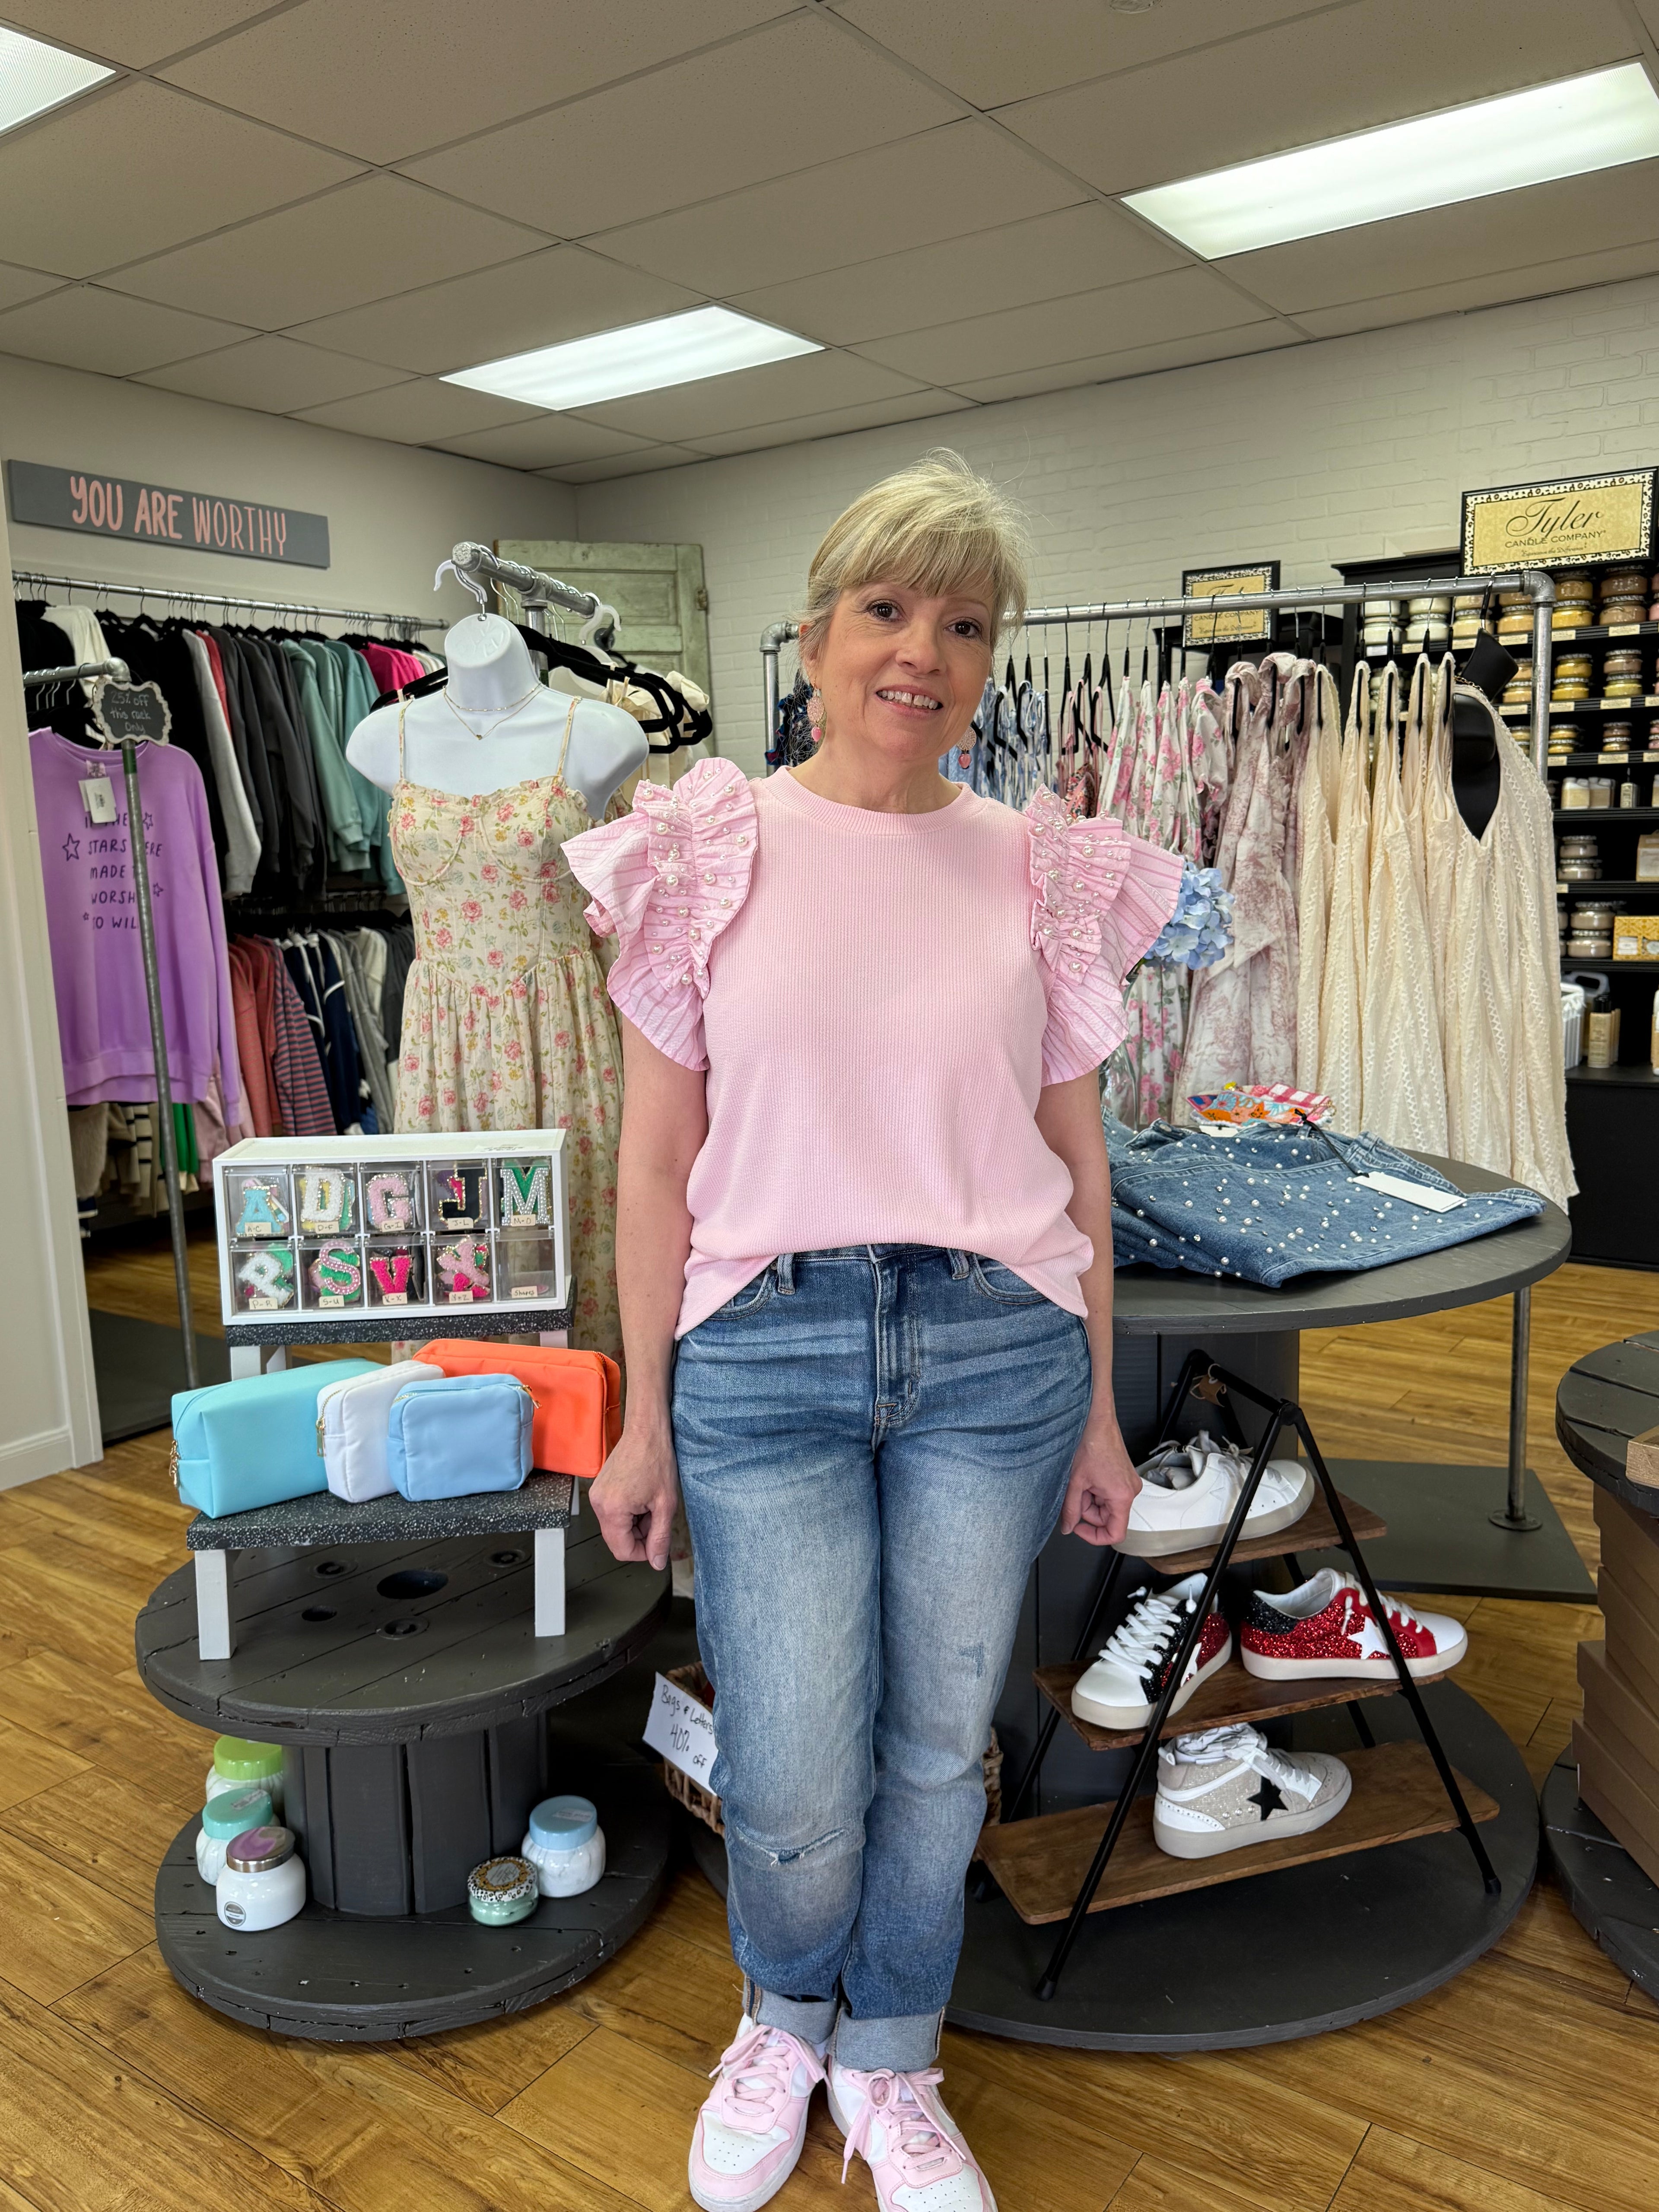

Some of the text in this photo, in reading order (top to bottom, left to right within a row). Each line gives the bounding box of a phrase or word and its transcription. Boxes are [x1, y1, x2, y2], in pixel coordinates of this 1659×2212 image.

[70, 476, 286, 556] YOU ARE WORTHY
[1506, 497, 1604, 538] Tyler
[1505, 531, 1603, 548] CANDLE COMPANY
[1194, 612, 1223, 621] CANDE
[111, 707, 128, 719] this
[89, 839, 162, 857] STARS ERE
[90, 864, 126, 880] MADE
[92, 890, 135, 905] WORSH
[112, 916, 139, 929] WIL
[301, 1165, 345, 1222] D
[366, 1173, 412, 1230] G
[500, 1166, 550, 1226] M
[235, 1185, 283, 1234] A
[319, 1239, 361, 1295] S
[369, 1257, 412, 1294] V
[690, 1708, 713, 1735] Letters
[671, 1724, 690, 1752] 40%
